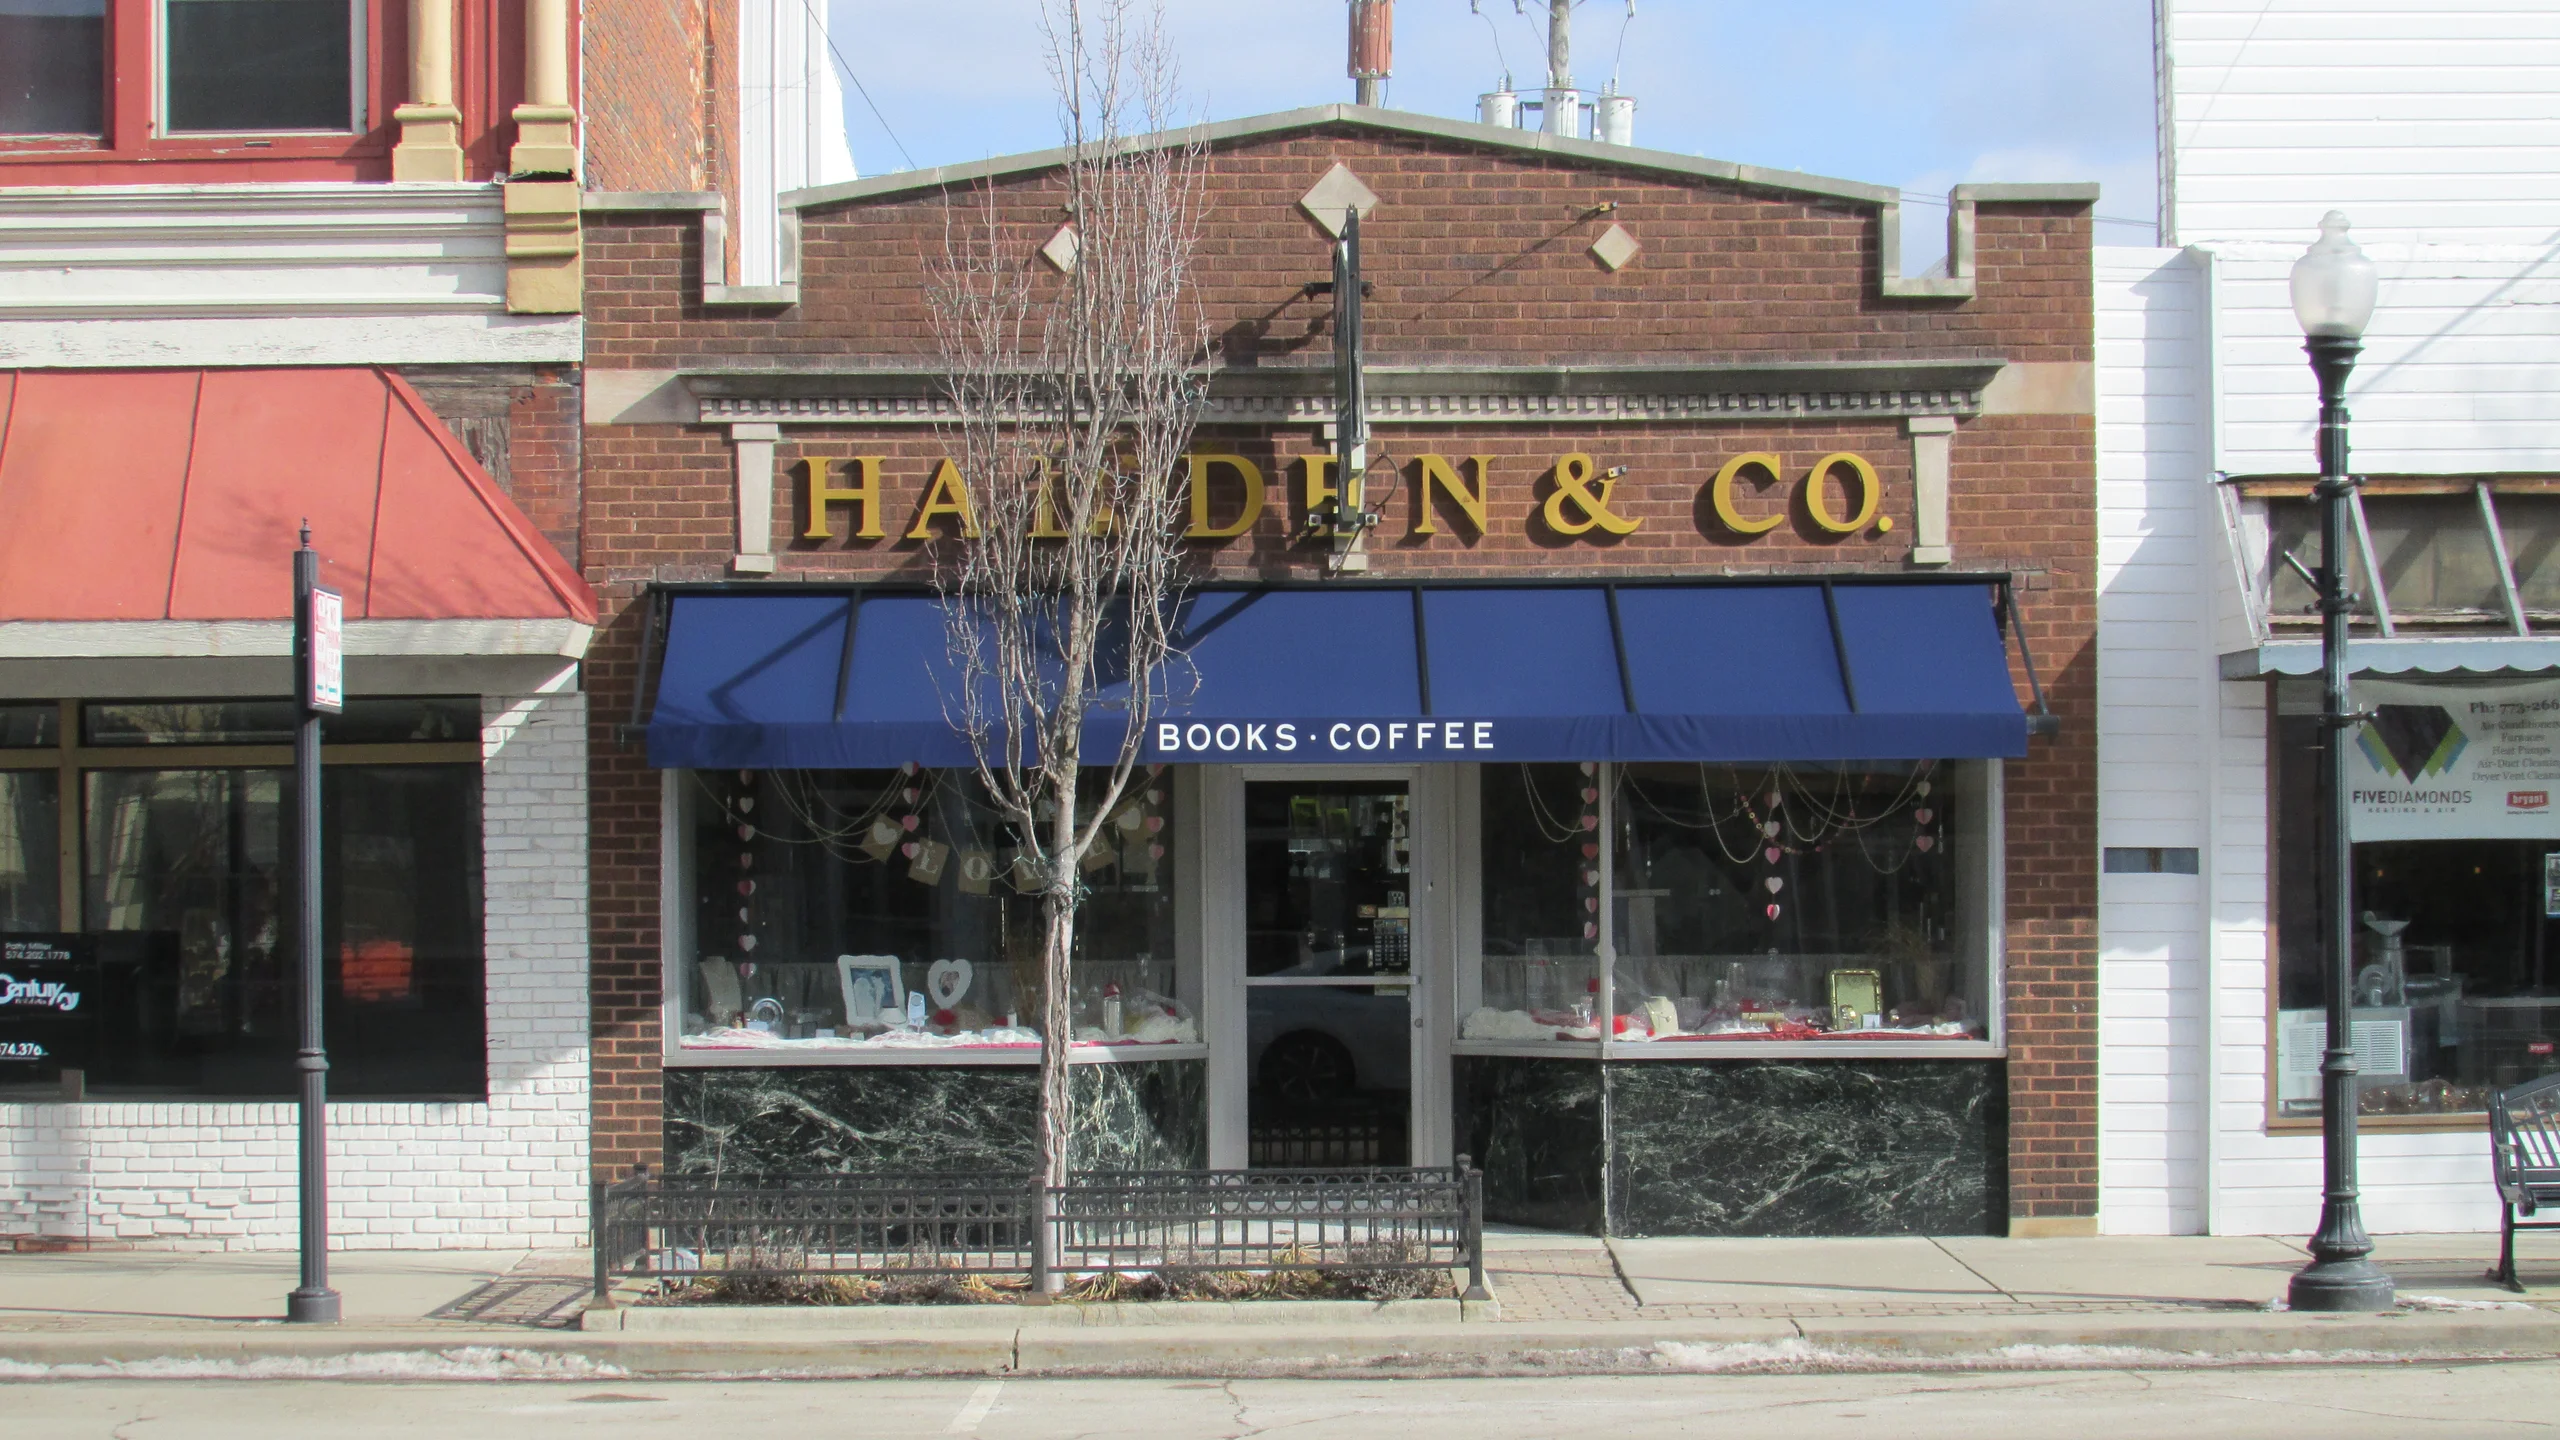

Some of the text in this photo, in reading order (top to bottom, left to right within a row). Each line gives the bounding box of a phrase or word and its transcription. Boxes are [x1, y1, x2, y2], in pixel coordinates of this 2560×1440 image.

[1544, 452, 1644, 536] &
[1713, 451, 1893, 534] CO.
[1158, 721, 1494, 751] BOOKS COFFEE
[2352, 790, 2472, 804] FIVEDIAMONDS
